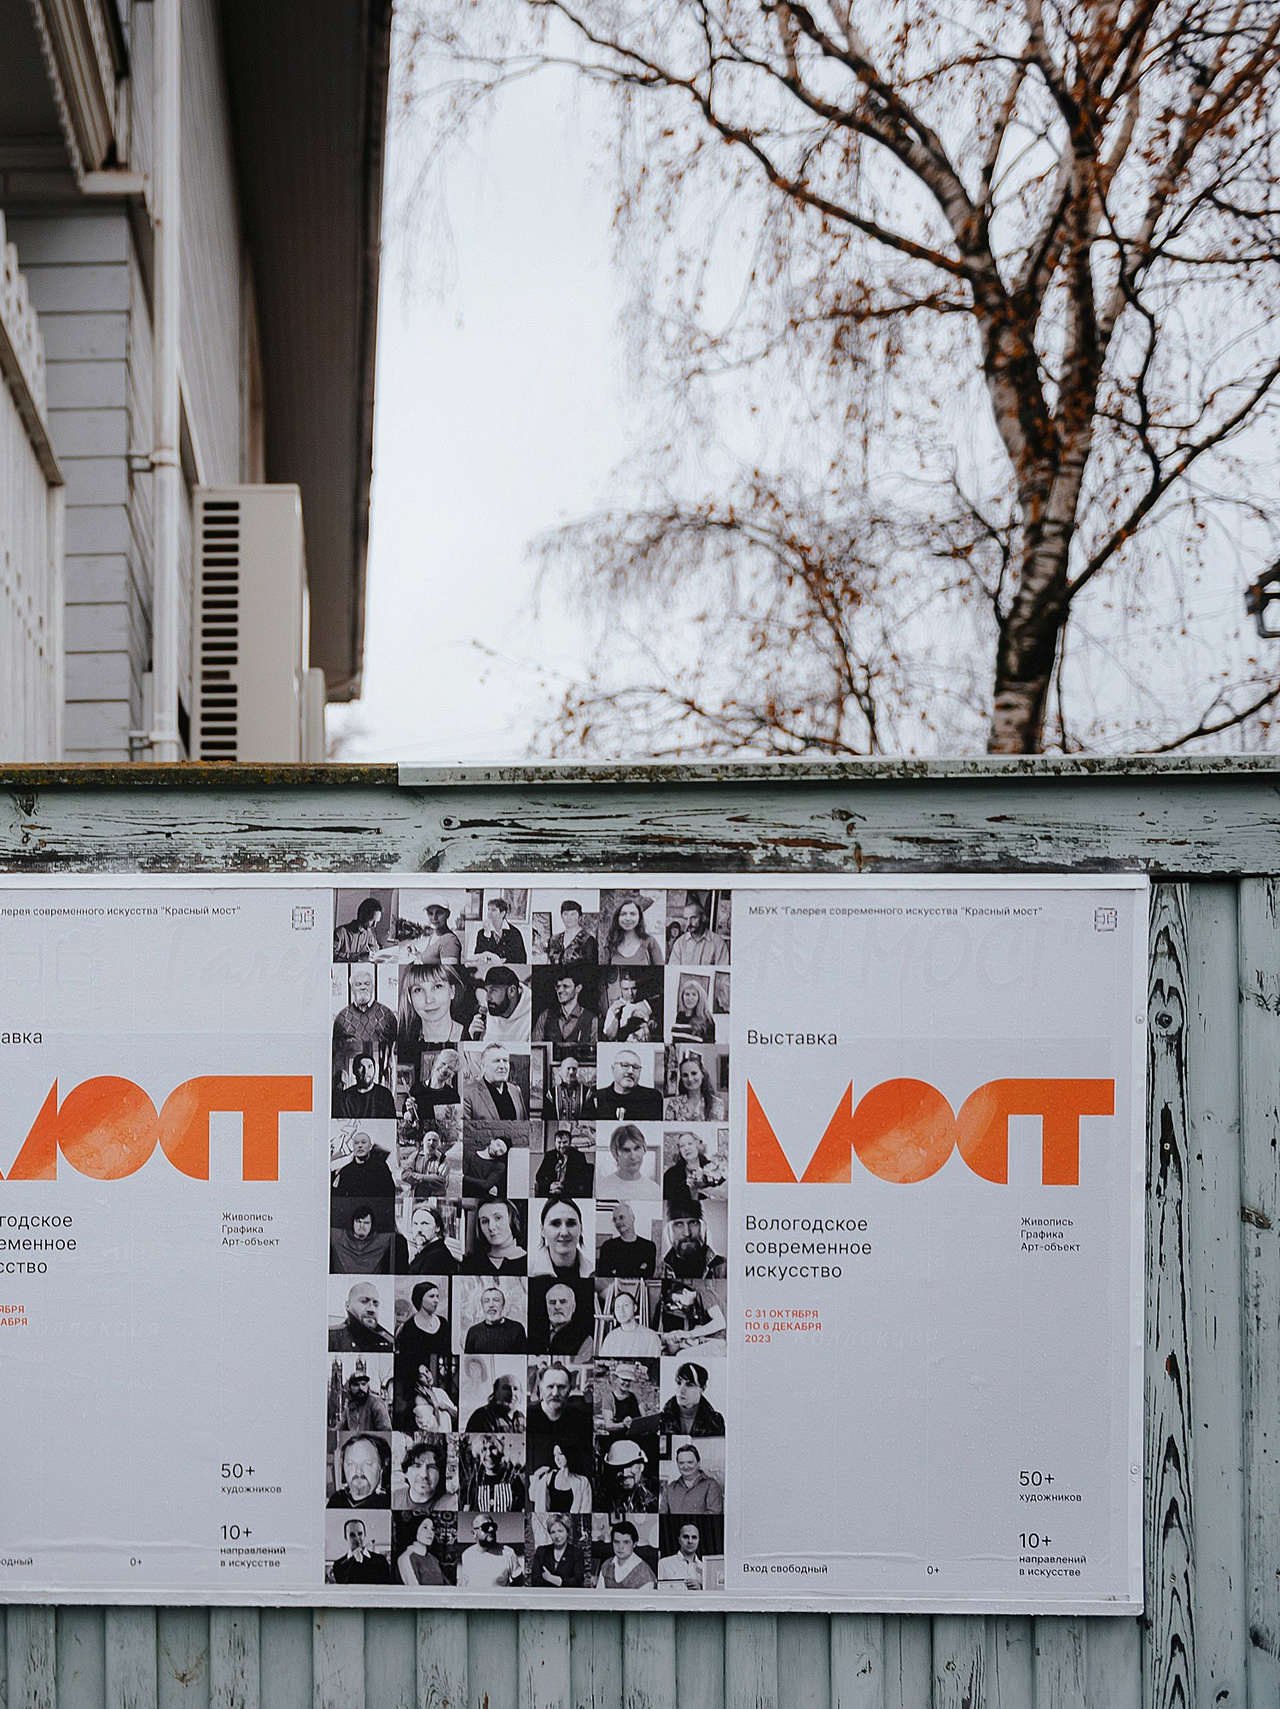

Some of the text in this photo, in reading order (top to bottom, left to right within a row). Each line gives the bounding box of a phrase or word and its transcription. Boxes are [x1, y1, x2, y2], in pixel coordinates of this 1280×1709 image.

[33, 906, 104, 918] современного
[107, 906, 158, 918] искусства
[160, 905, 209, 917] "Красный
[211, 905, 242, 916] мост"
[748, 905, 1043, 918] МБУК "Галерея современного искусства "Красный мост"
[747, 1029, 838, 1046] Выставка
[746, 1078, 1115, 1186] МОСТ
[221, 1212, 274, 1222] Живопись
[1020, 1216, 1074, 1227] Живопись
[221, 1224, 264, 1236] Графика
[745, 1214, 868, 1235] Вологодское
[1020, 1229, 1064, 1241] Графика
[221, 1236, 280, 1248] Арт-объект
[1020, 1241, 1081, 1253] Арт-объект
[745, 1241, 872, 1259] современное
[745, 1265, 842, 1282] искусство
[744, 1308, 819, 1319] С 31 ОКТЯБРЯ
[745, 1321, 822, 1333] ПО 6 ДЕКАБРЯ
[744, 1334, 771, 1344] 2023
[220, 1462, 256, 1479] 50+
[1019, 1470, 1055, 1487] 50+
[220, 1485, 282, 1495] художников
[1018, 1493, 1082, 1503] художников
[220, 1524, 253, 1541] 10+
[1018, 1532, 1053, 1549] 10+
[219, 1546, 286, 1557] направлений
[129, 1557, 143, 1567] 0+
[220, 1559, 281, 1570] в искусстве
[1018, 1554, 1087, 1566] направлений
[742, 1563, 828, 1575] Вход свободный
[926, 1565, 940, 1575] 0+
[1018, 1568, 1082, 1579] в искусстве
